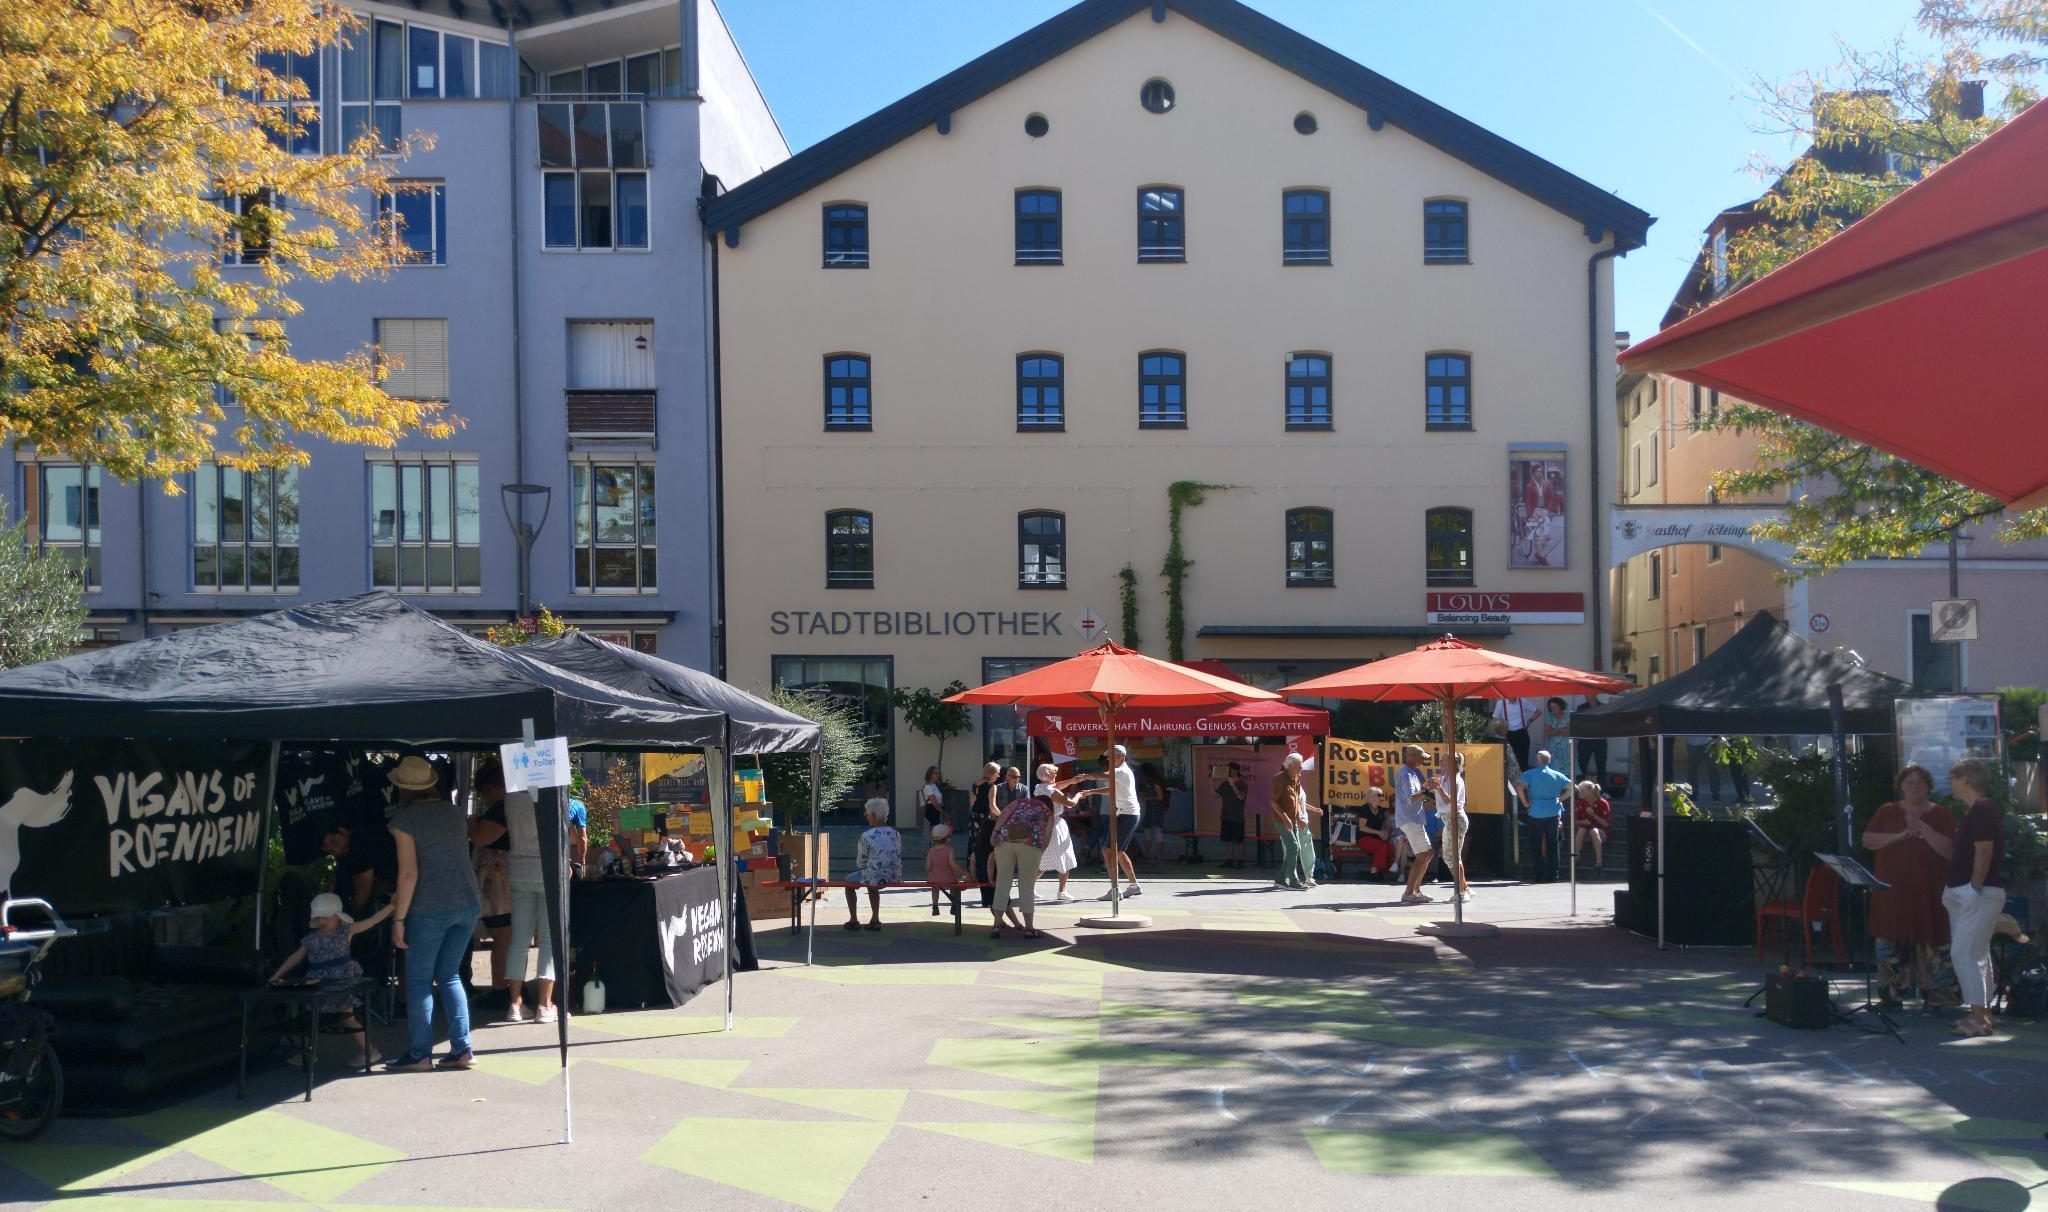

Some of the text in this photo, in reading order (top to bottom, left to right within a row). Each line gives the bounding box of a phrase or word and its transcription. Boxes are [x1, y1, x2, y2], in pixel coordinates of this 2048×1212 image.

[770, 610, 1063, 636] STADTBIBLIOTHEK
[1437, 613, 1511, 624] Balancing Beauty
[1065, 722, 1138, 731] GEWERKSHAFT
[536, 749, 551, 758] WC
[1329, 742, 1464, 767] Roseni
[233, 772, 256, 801] OF
[1329, 764, 1360, 786] ist
[109, 811, 260, 878] ROENHEIM
[690, 898, 722, 936] VEGAN
